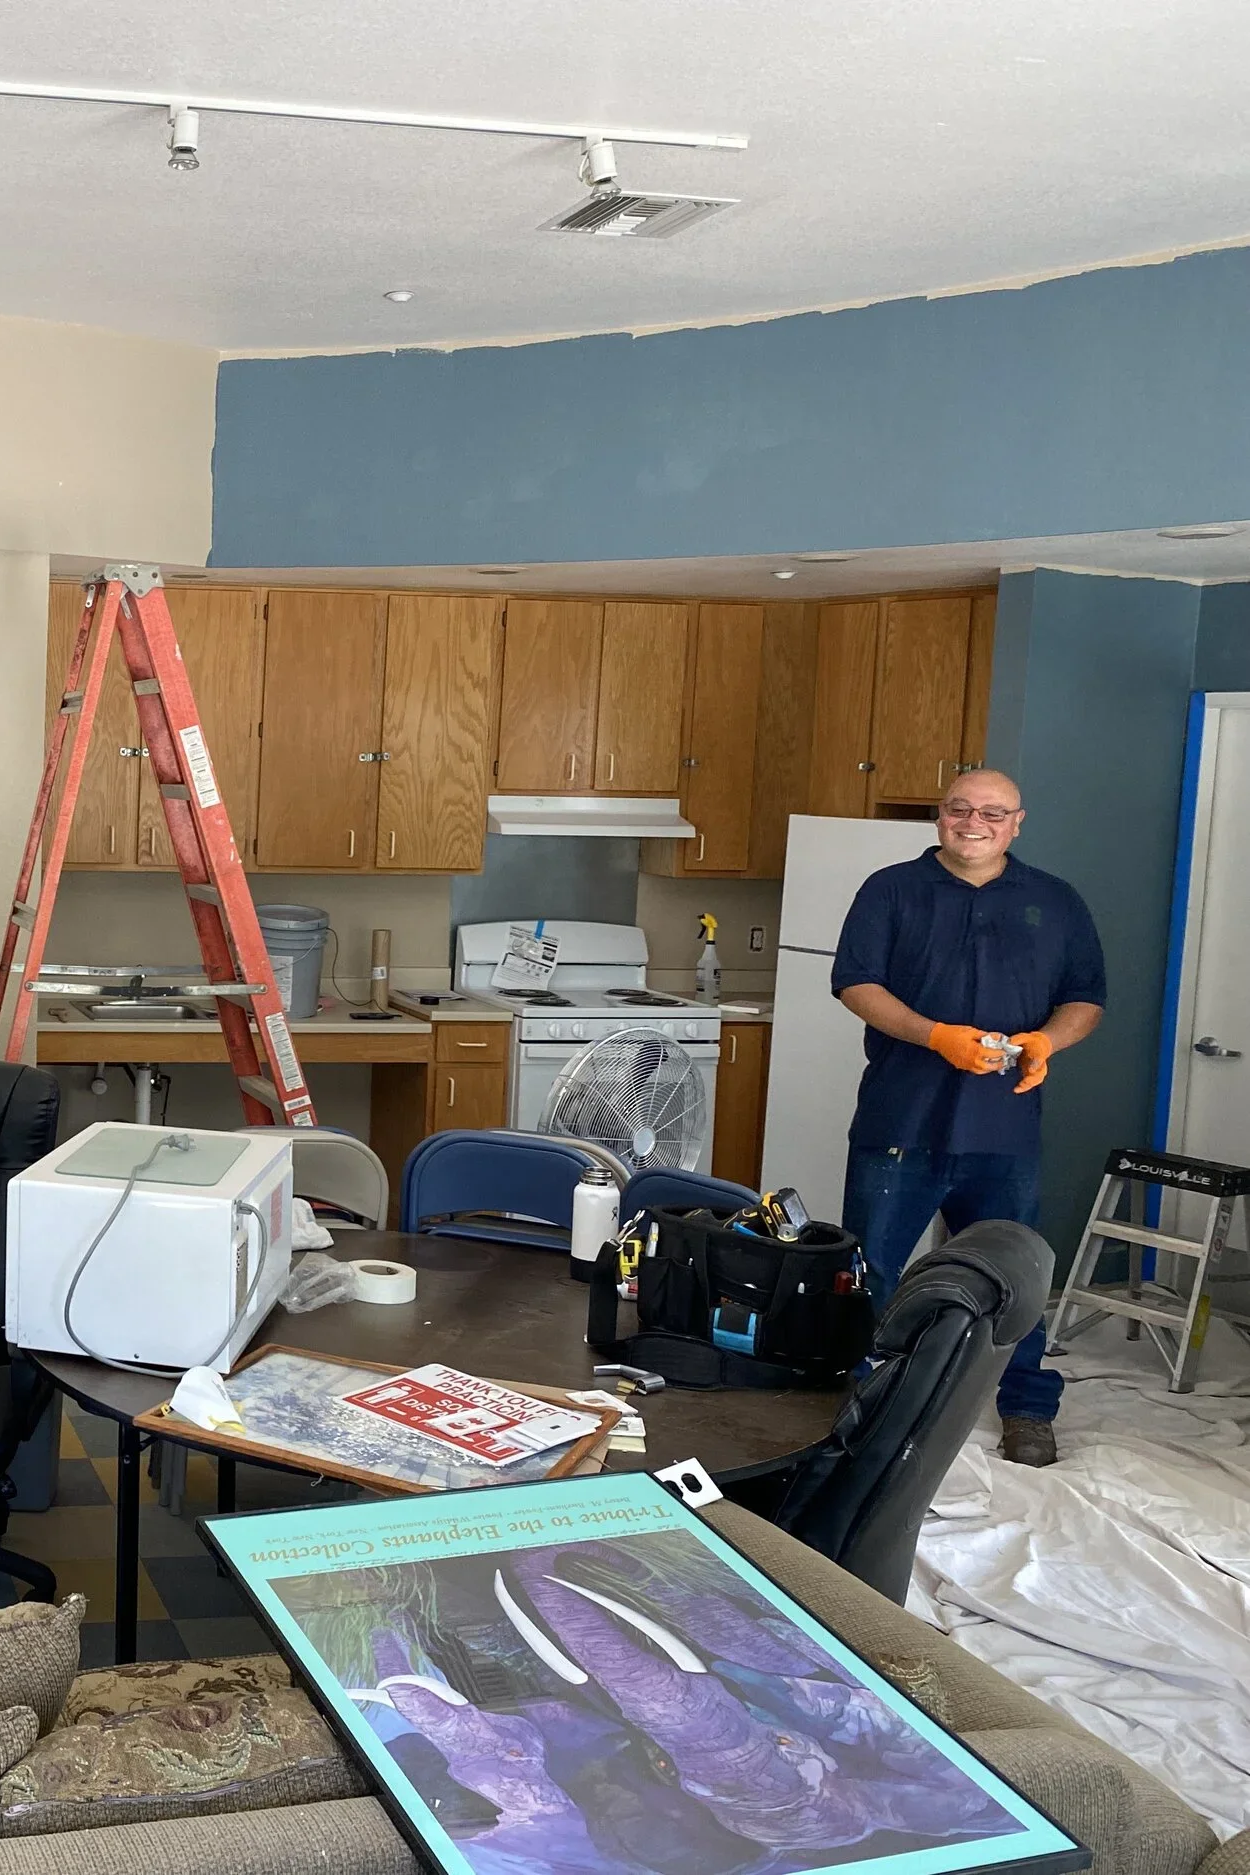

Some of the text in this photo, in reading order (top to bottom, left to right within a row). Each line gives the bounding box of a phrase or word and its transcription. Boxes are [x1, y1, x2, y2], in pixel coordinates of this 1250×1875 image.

[435, 1369, 495, 1396] THANK
[498, 1392, 540, 1409] YOU
[551, 1515, 574, 1528] to
[579, 1504, 674, 1524] Tribute
[382, 1522, 503, 1549] Elephants
[509, 1518, 547, 1535] the
[250, 1539, 375, 1564] Collection
